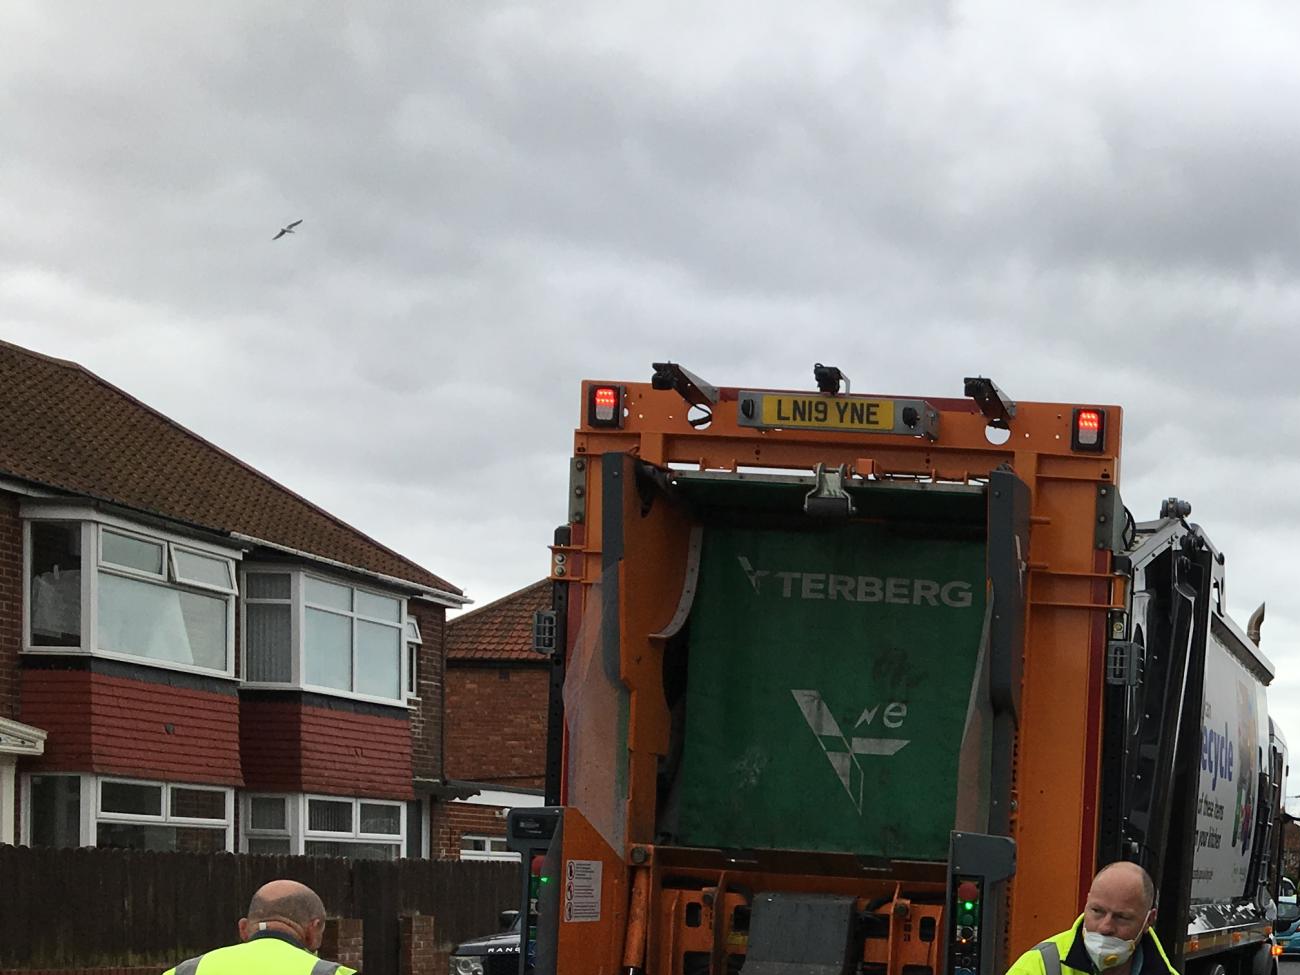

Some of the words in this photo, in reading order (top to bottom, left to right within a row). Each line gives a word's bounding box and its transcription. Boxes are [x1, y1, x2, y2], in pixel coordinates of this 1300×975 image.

[776, 399, 828, 422] LN19
[834, 401, 880, 425] YNE
[775, 571, 973, 608] TERBERG
[1201, 722, 1233, 791] ecycle
